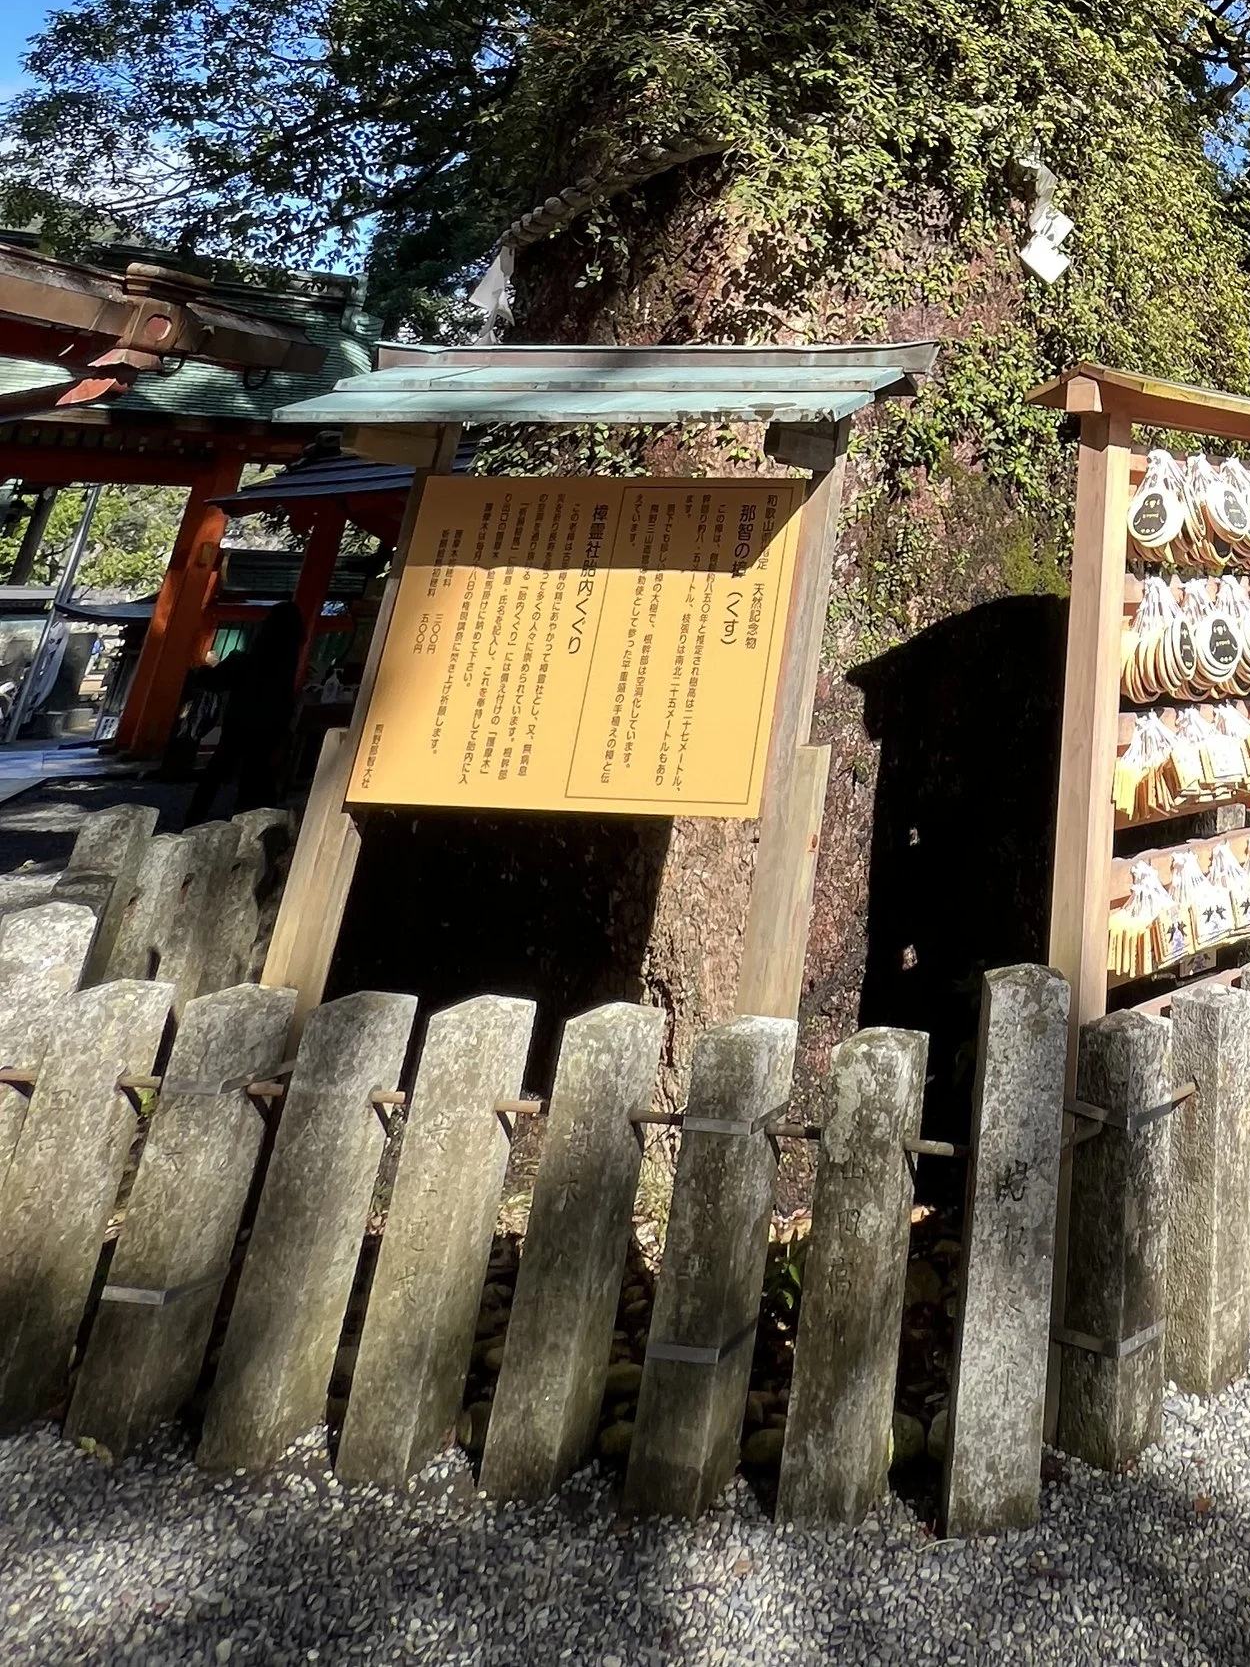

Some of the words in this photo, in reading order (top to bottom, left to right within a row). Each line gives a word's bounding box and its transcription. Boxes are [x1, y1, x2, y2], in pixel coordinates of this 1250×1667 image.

[563, 503, 609, 655] 樟霊社胎内くぐり
[743, 582, 765, 649] 天然記念物
